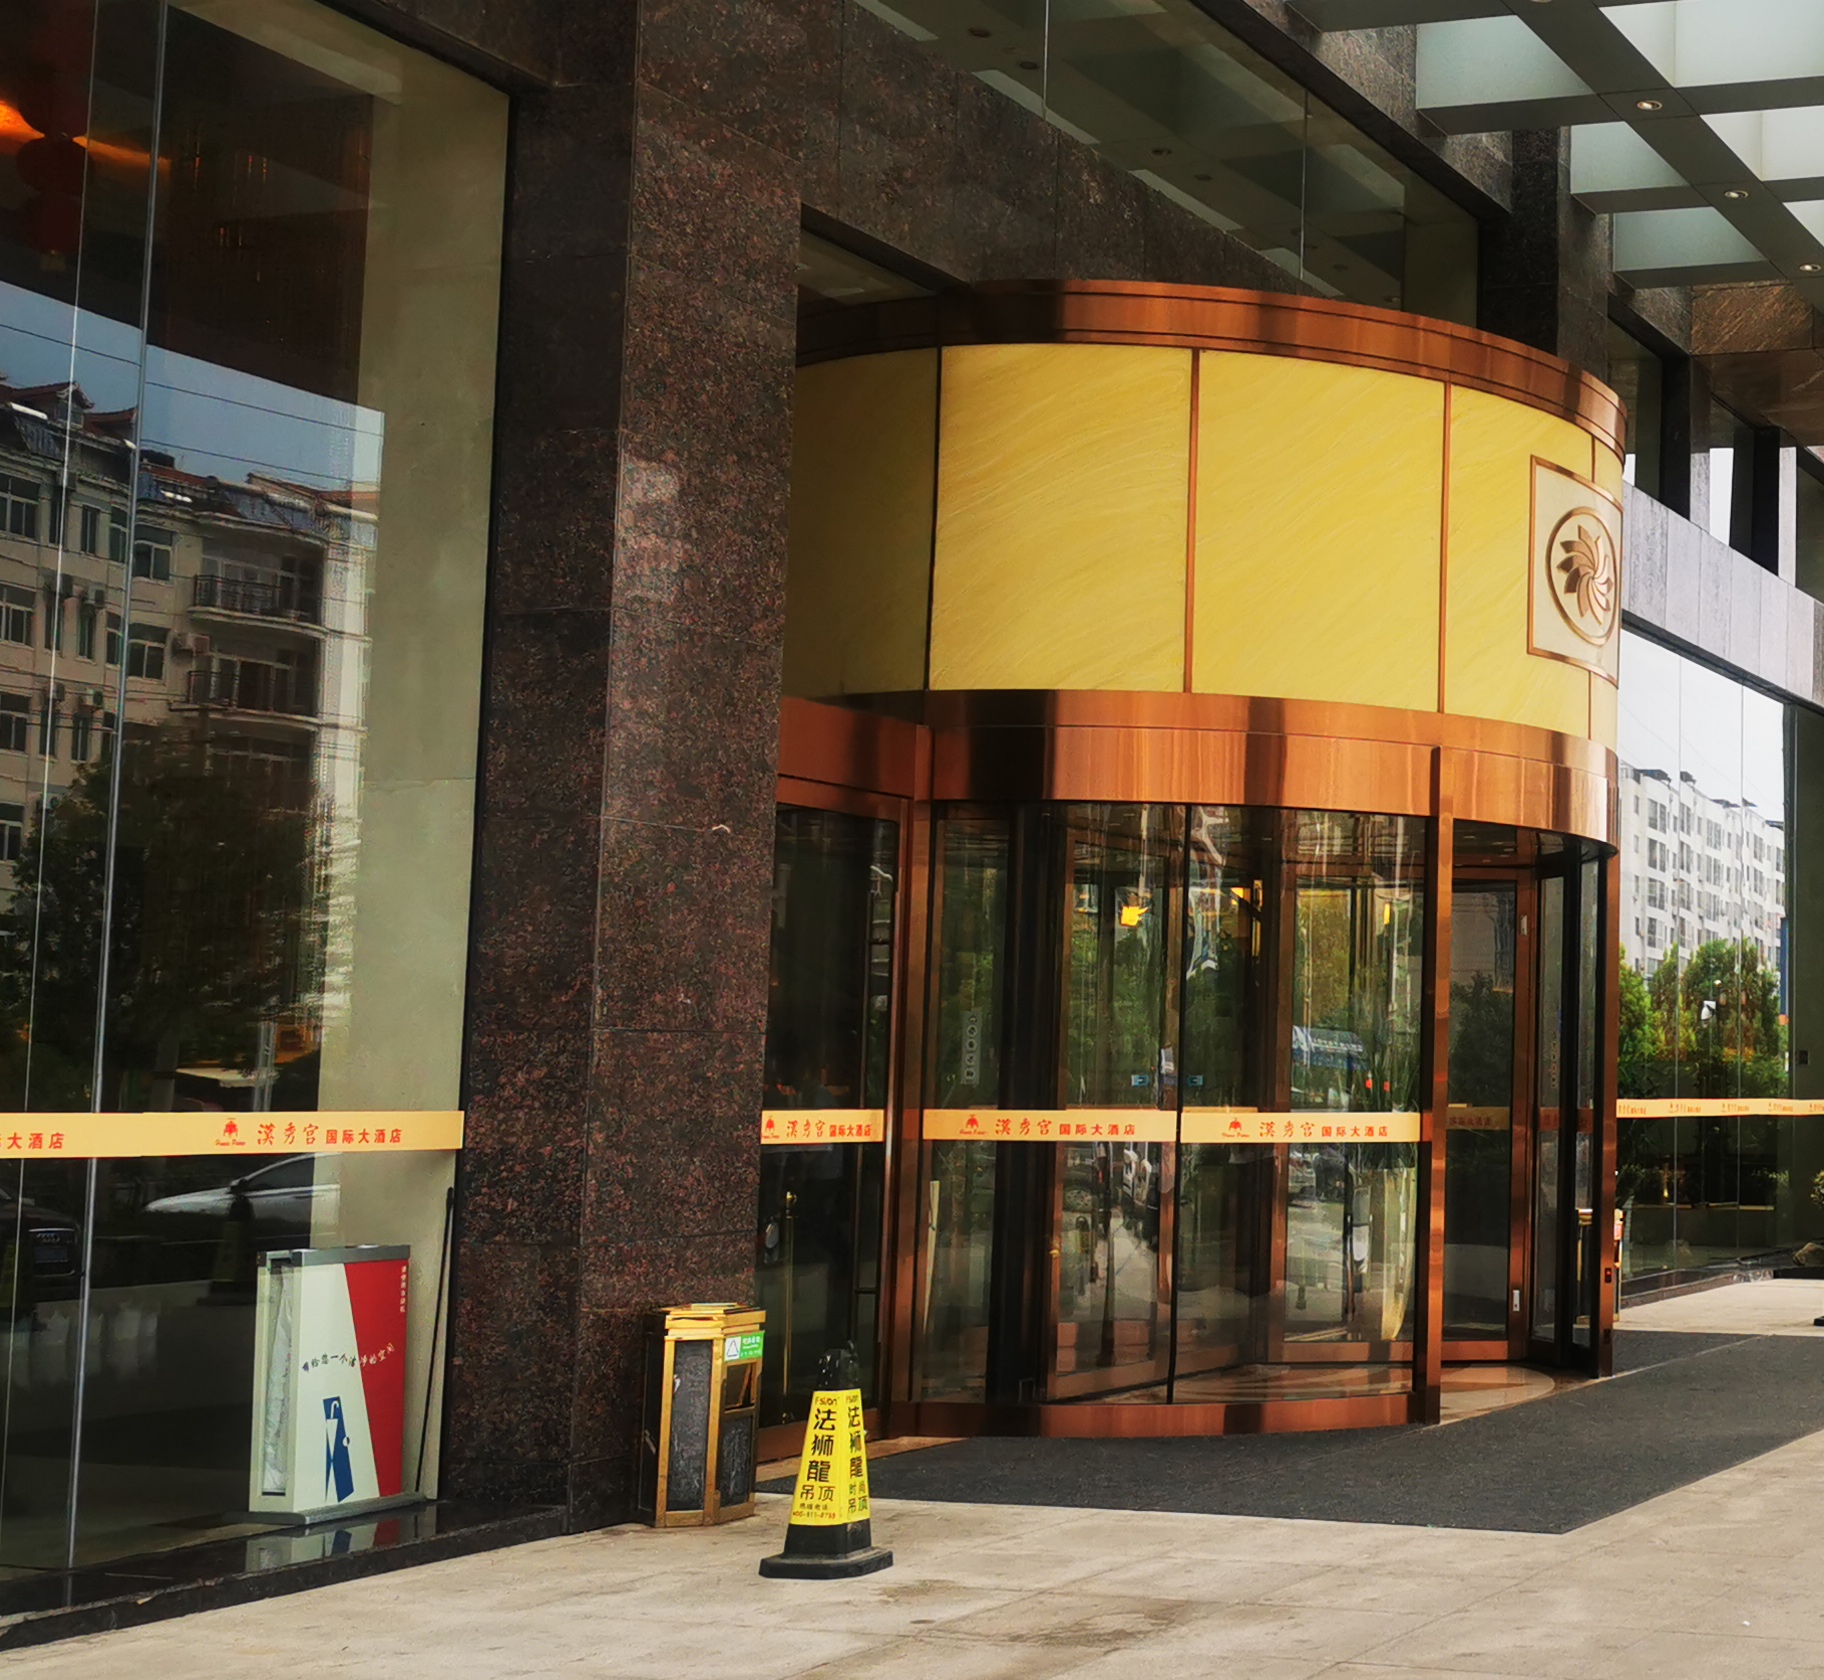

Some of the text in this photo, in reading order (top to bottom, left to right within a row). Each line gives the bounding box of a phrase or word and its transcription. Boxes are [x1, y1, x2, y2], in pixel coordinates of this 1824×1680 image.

[0, 1132, 65, 1150] 大酒店
[800, 1484, 836, 1502] 吊顶
